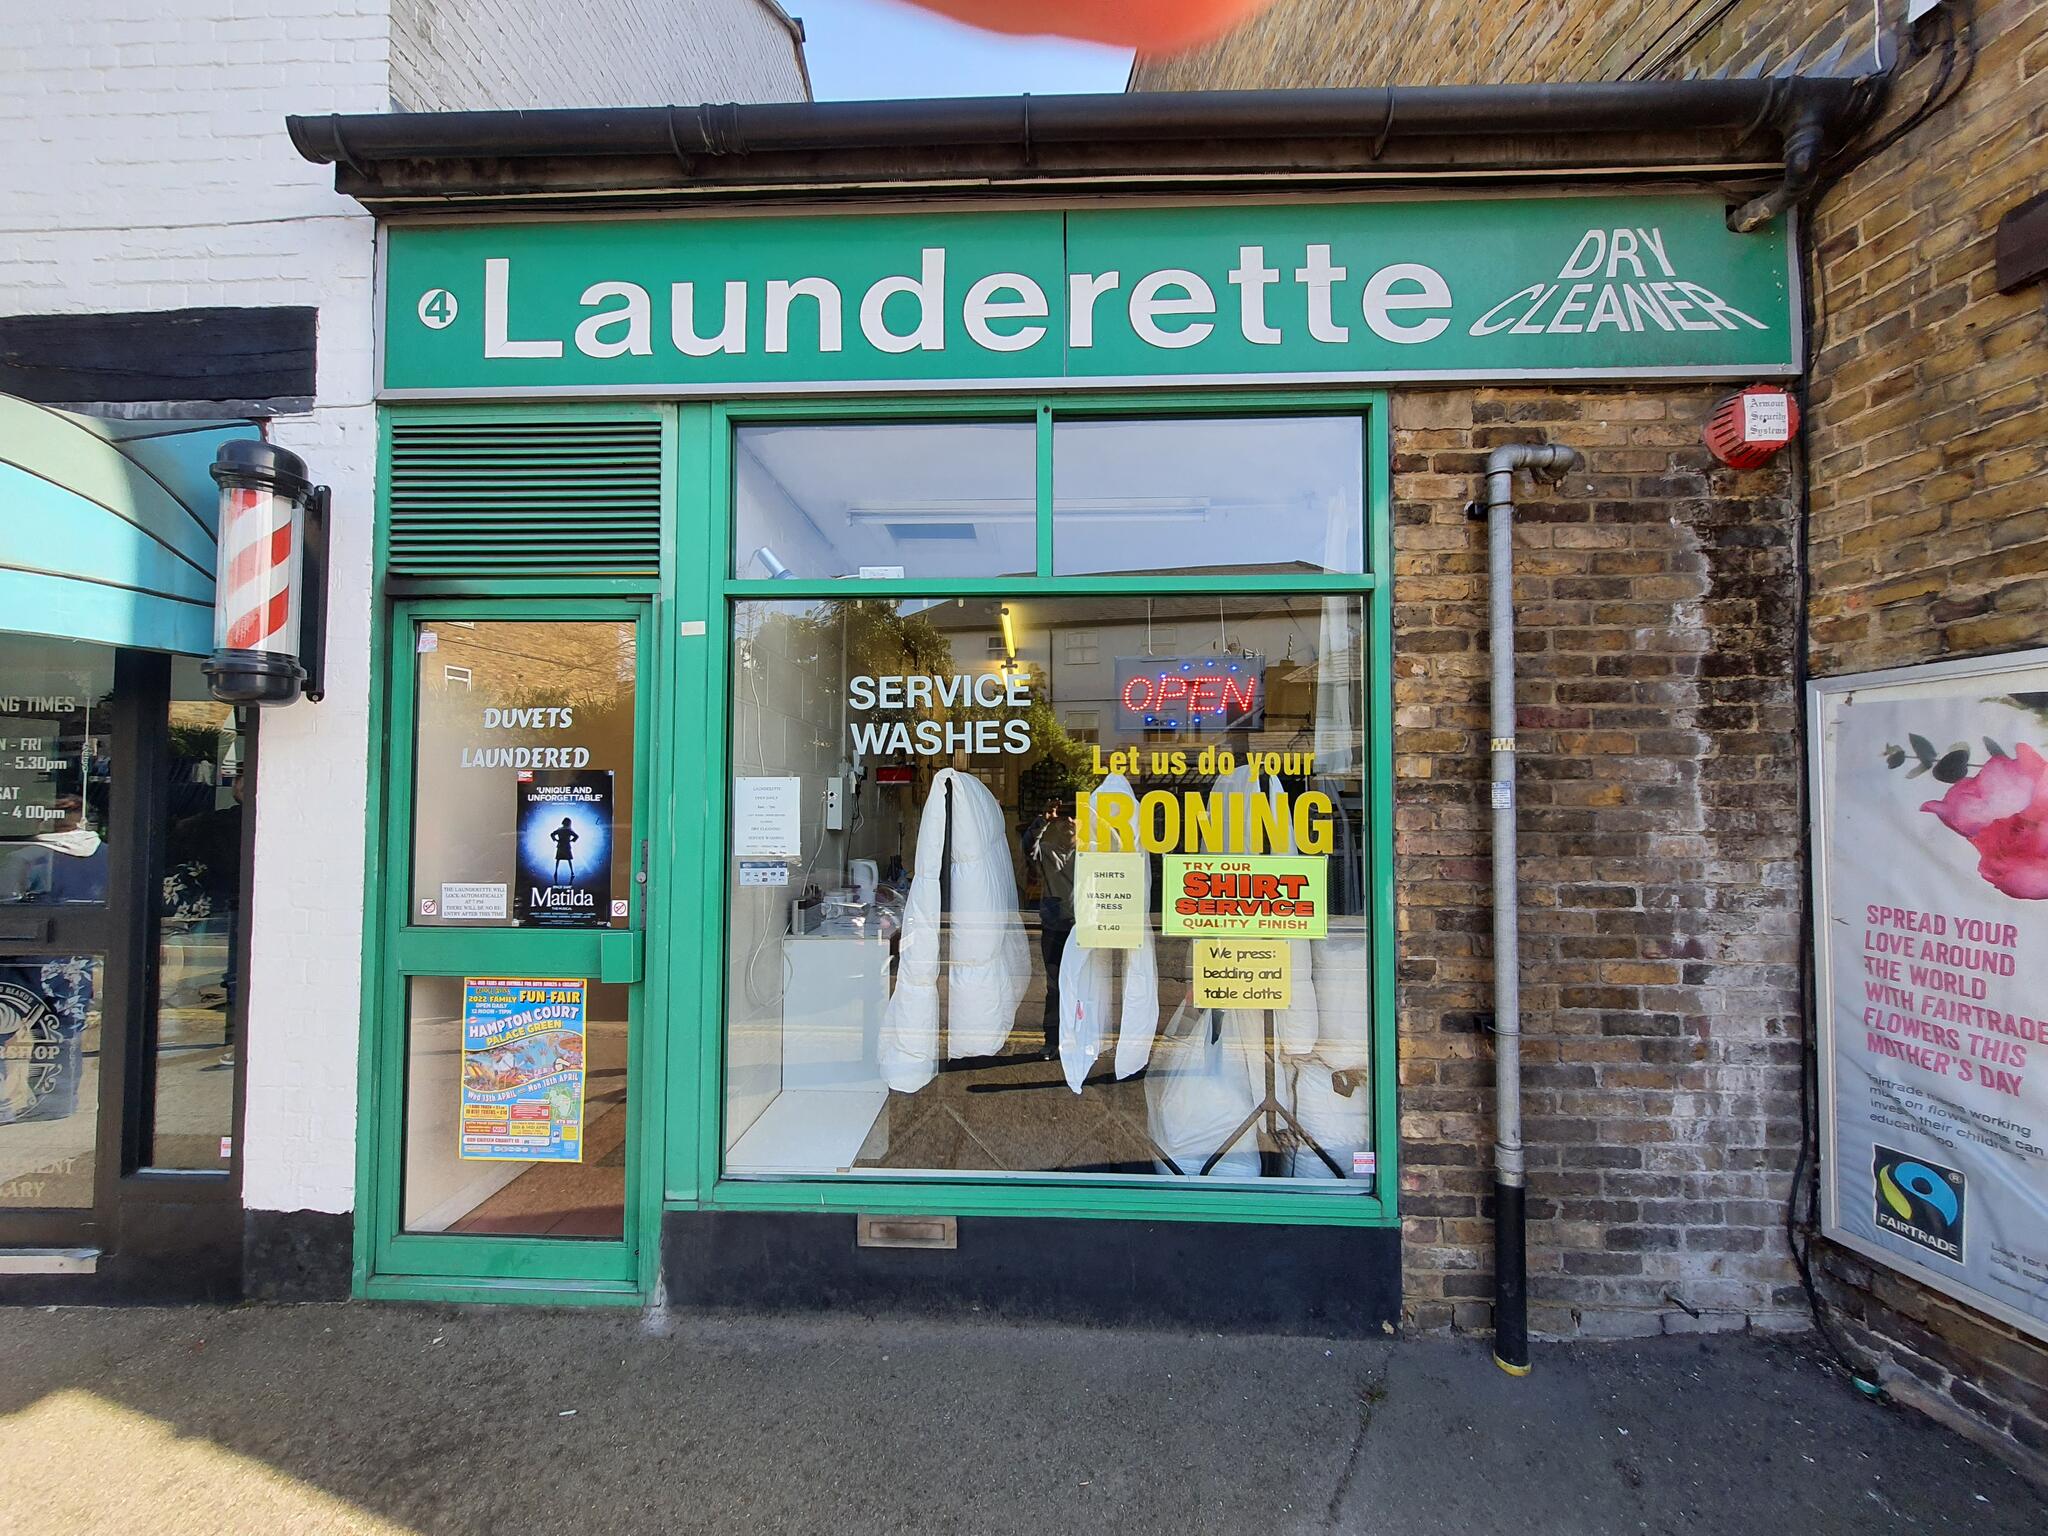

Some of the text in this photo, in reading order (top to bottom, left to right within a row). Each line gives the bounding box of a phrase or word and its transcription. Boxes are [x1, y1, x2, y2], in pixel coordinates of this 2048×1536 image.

[1556, 228, 1677, 279] DRY
[424, 243, 1454, 360] 4 Launderette
[1468, 281, 1770, 337] CLEANER
[1750, 398, 1785, 408] Armour
[1750, 411, 1786, 423] Security
[1750, 425, 1787, 437] Systems
[26, 696, 76, 712] TIMES
[848, 673, 1032, 710] SERVICE
[1121, 676, 1258, 713] OPEN
[483, 707, 574, 729] DUVETS
[20, 738, 42, 751] FRI
[849, 719, 1032, 756] WASHES
[15, 756, 68, 772] 5.30pm
[460, 747, 591, 769] LAUNDERED
[1091, 745, 1315, 783] Let us do your
[573, 786, 593, 794] AND
[1075, 790, 1334, 854] IRONING
[1093, 871, 1126, 879] SHIRTS
[1182, 862, 1251, 871] TRY OUR
[530, 887, 594, 907] Matilda
[1087, 892, 1132, 900] WASH AND
[1182, 870, 1310, 900] SHIRT
[1095, 903, 1123, 911] PRESS
[1175, 898, 1315, 918] SERVICE
[1096, 924, 1121, 932] £1.40
[1182, 918, 1308, 930] QUALITY FINISH
[1866, 904, 2018, 949] SPREAD YOUR
[1209, 947, 1277, 962] We press:
[1864, 929, 2016, 977] LOVE AROUND
[1203, 967, 1282, 983] bedding and
[1863, 955, 1988, 1000] THE WORLD
[468, 995, 487, 1003] 2022
[489, 995, 517, 1003] FAMILY
[520, 990, 581, 1004] FUN-FAIR
[1203, 984, 1282, 1000] table cloths
[469, 1005, 580, 1038] HAMPTON COURT
[1864, 981, 2048, 1046] WITH FAIRTRADE
[486, 1020, 563, 1047] PALACE GREEN
[1863, 1006, 2028, 1068] FLOWERS THIS
[1866, 1031, 2024, 1097] MOTHER'S DAY
[497, 1090, 517, 1101] APRIL
[559, 1073, 579, 1083] APRIL
[1868, 1073, 2032, 1139] airtrade working
[1870, 1099, 1910, 1118] inves
[1919, 1115, 1953, 1134] their
[1869, 1112, 1932, 1137] educatio
[1904, 1099, 1924, 1111] on
[1928, 1104, 1974, 1128] flowe
[2015, 1140, 2045, 1157] can
[1879, 1213, 1959, 1256] FAIRTRADE
